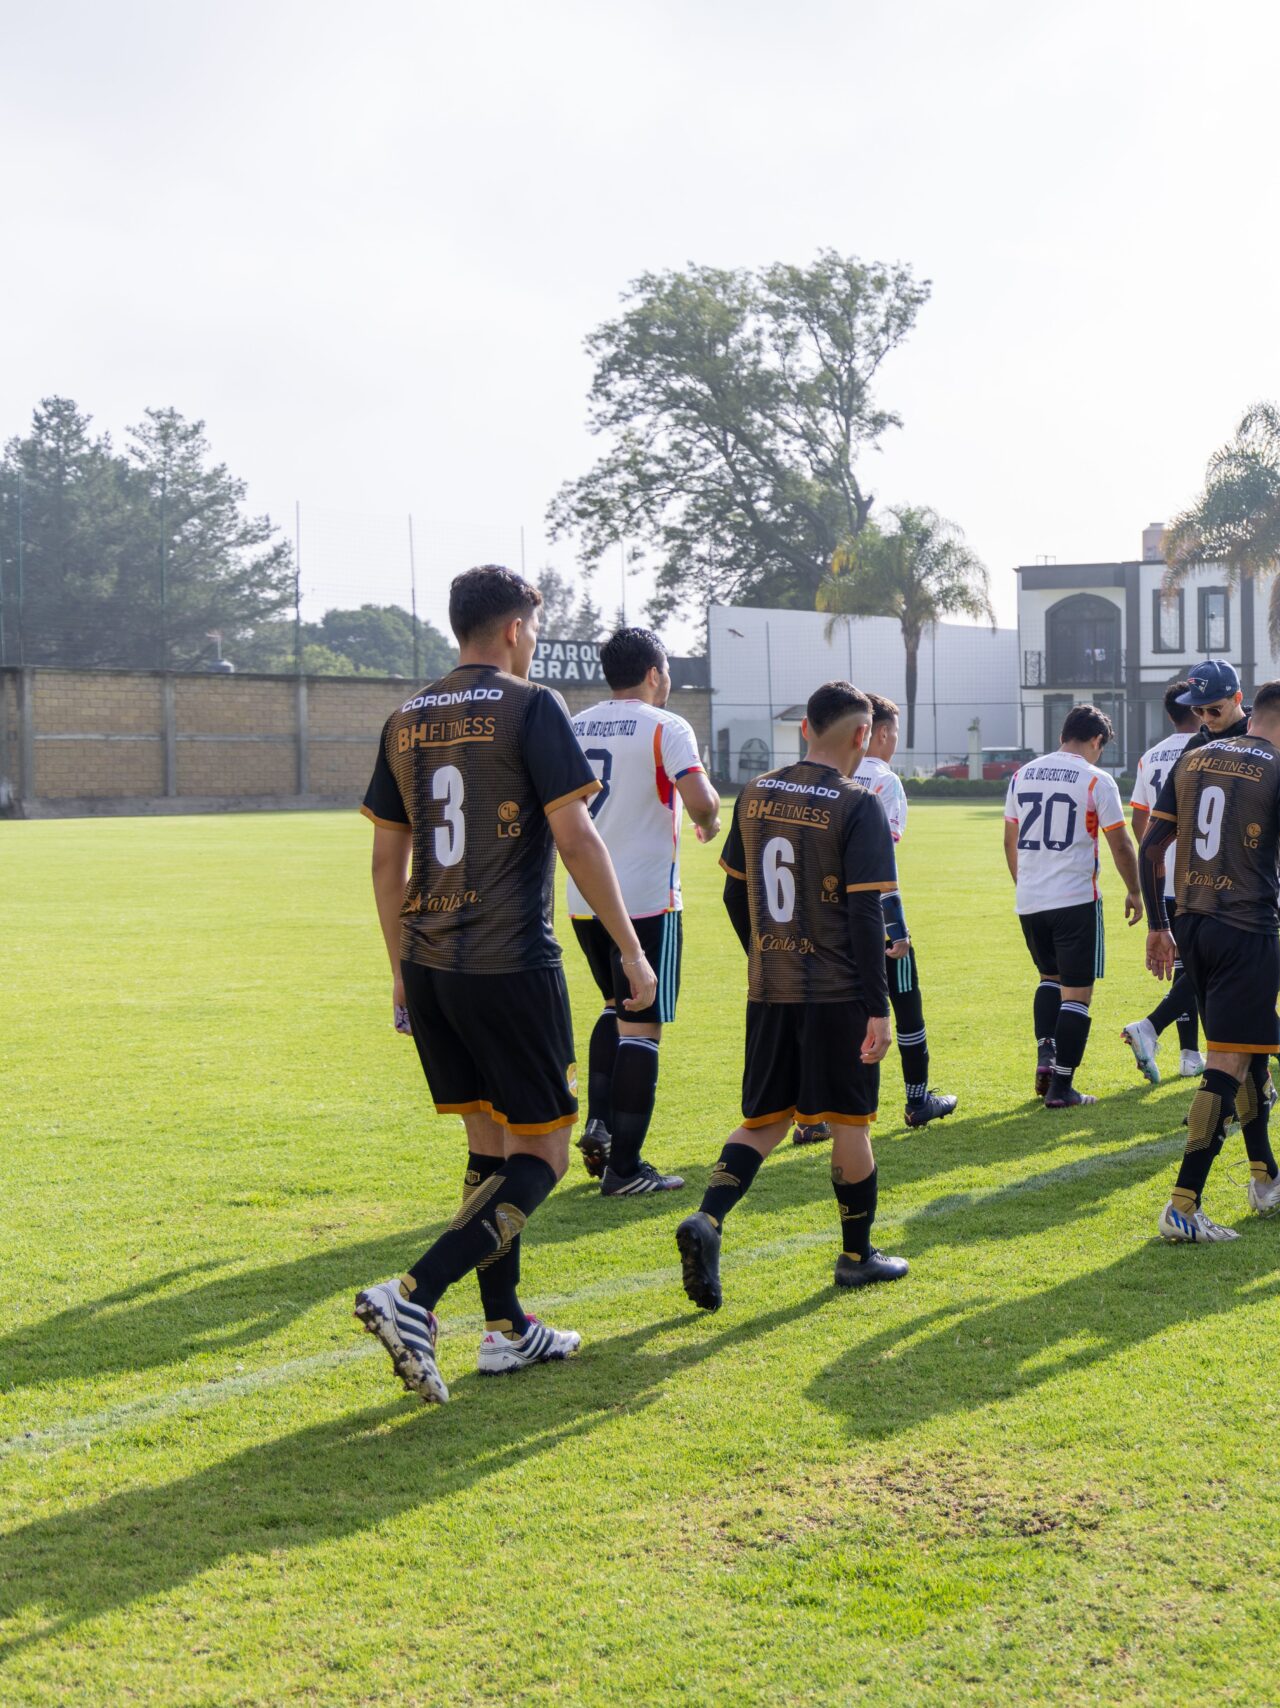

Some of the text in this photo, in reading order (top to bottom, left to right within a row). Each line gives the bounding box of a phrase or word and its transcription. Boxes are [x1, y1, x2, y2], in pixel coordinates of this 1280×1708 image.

[538, 643, 601, 661] PARQU
[402, 689, 504, 713] CORONADO
[1201, 742, 1274, 761] CORONADO
[756, 779, 841, 799] CORONADO
[432, 765, 466, 867] 3
[1017, 792, 1078, 851] 20
[1195, 786, 1226, 861] 9
[497, 822, 521, 838] LG
[1243, 835, 1259, 849] LG
[762, 836, 796, 923] 6
[821, 890, 840, 904] LG
